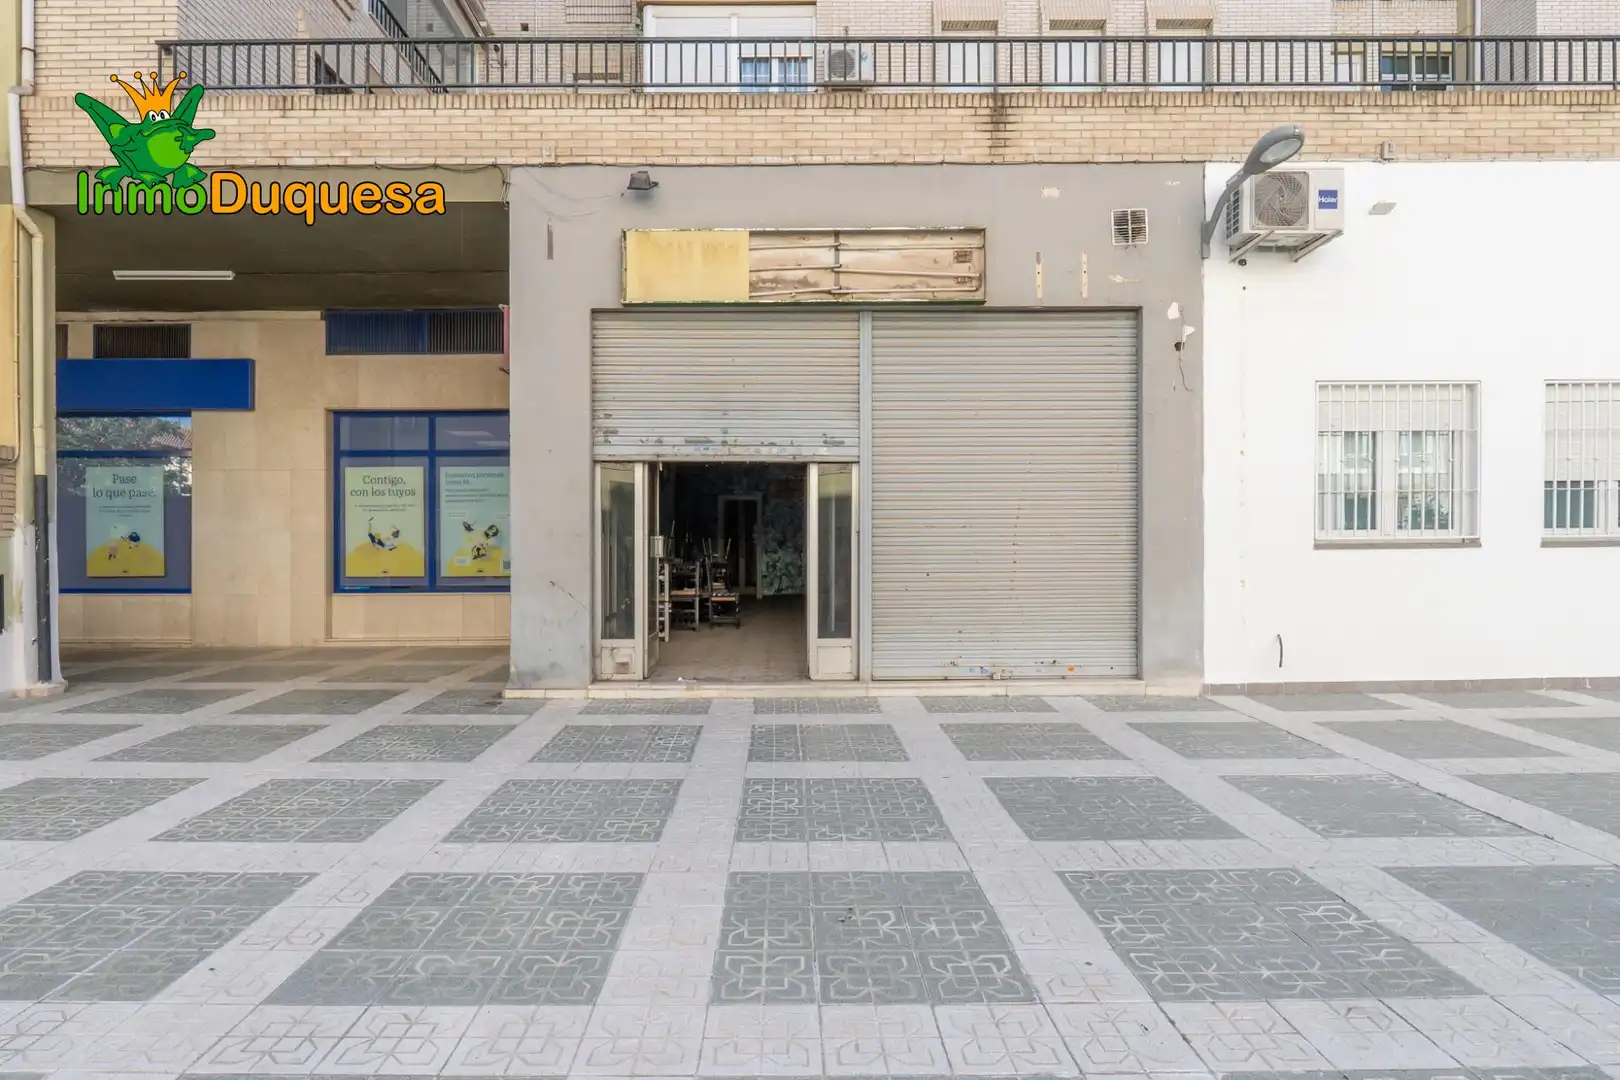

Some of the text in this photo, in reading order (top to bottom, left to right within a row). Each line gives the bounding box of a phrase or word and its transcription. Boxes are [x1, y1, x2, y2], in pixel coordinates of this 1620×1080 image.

[1318, 196, 1338, 204] Haier
[112, 473, 137, 485] Pase
[362, 475, 406, 487] Contigo,
[92, 487, 103, 498] lo
[105, 489, 126, 501] que
[350, 487, 416, 499] con los tuyos
